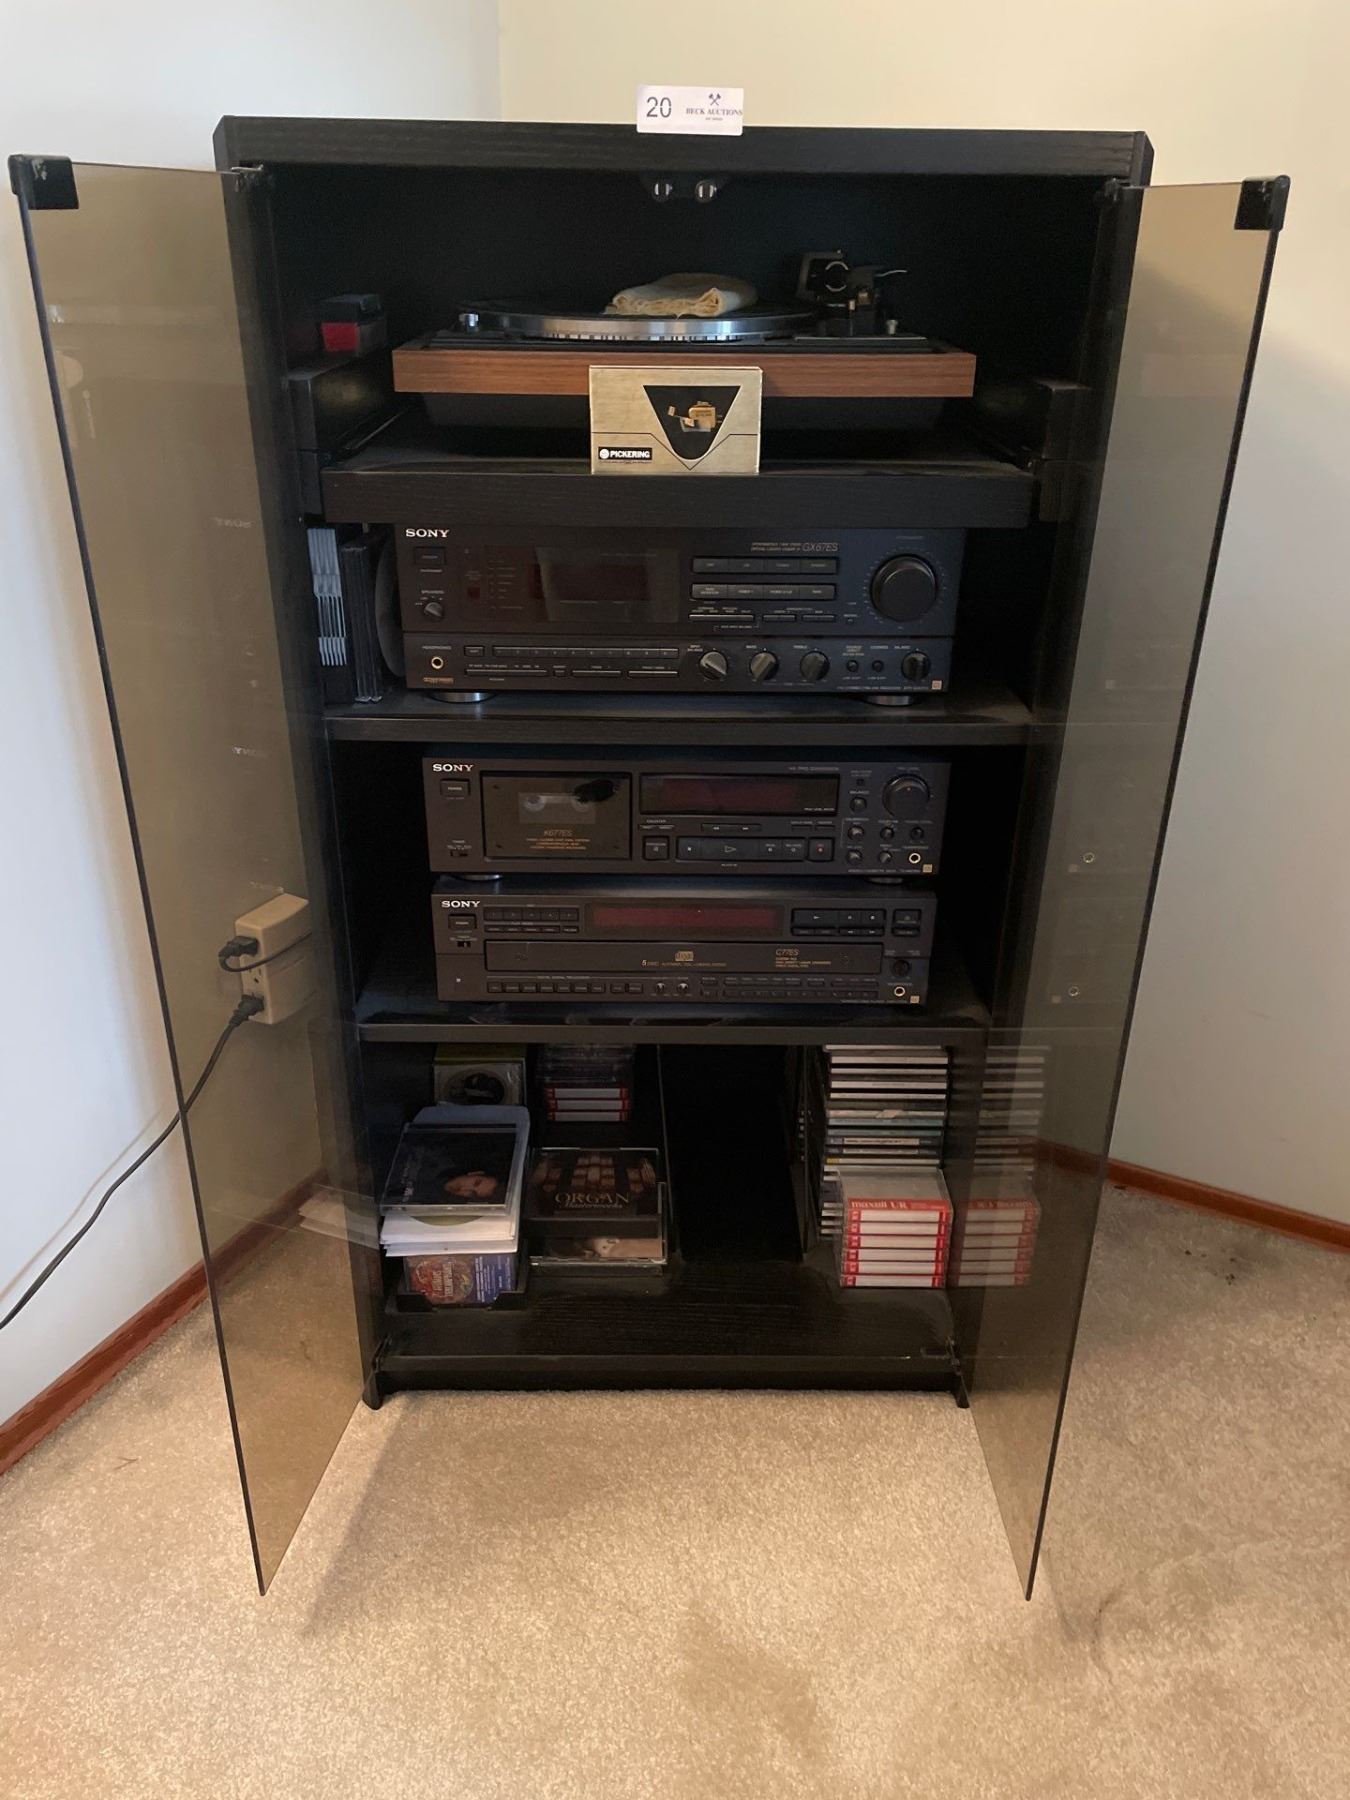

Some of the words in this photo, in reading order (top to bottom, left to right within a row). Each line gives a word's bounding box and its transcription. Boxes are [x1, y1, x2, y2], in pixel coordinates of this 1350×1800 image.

[646, 96, 672, 118] 20
[686, 107, 705, 116] BECK
[708, 108, 743, 117] AUCTIONS
[609, 450, 650, 459] PICKERING
[405, 529, 449, 538] SONY
[432, 763, 474, 772] SONY
[441, 900, 481, 909] SONY
[554, 1192, 630, 1203] ORGAN
[851, 1201, 888, 1209] maxell
